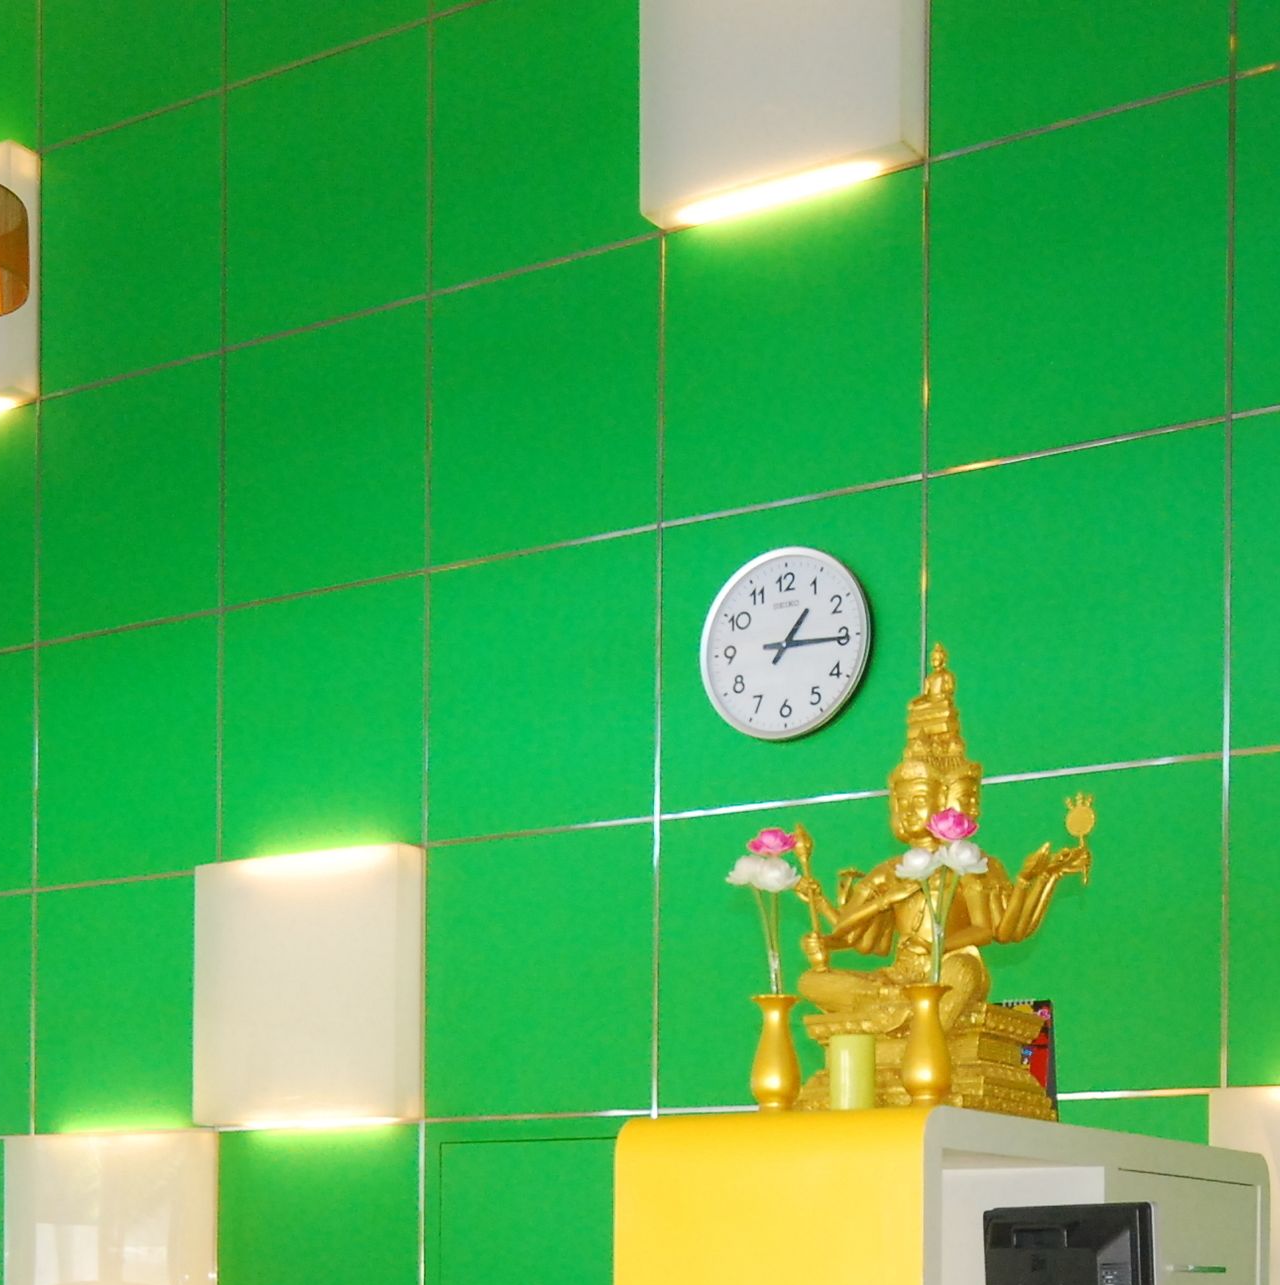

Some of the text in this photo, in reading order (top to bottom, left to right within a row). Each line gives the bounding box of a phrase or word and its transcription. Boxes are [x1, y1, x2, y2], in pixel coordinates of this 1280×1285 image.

[775, 572, 796, 593] 12
[810, 577, 818, 595] 1
[749, 586, 766, 606] 11
[830, 594, 843, 614] 2
[728, 611, 752, 632] 10
[836, 626, 851, 646] 3
[723, 645, 737, 665] 9
[829, 660, 842, 679] 4
[732, 674, 745, 694] 8
[753, 694, 764, 714] 7
[810, 686, 822, 706] 5
[779, 699, 793, 718] 6
